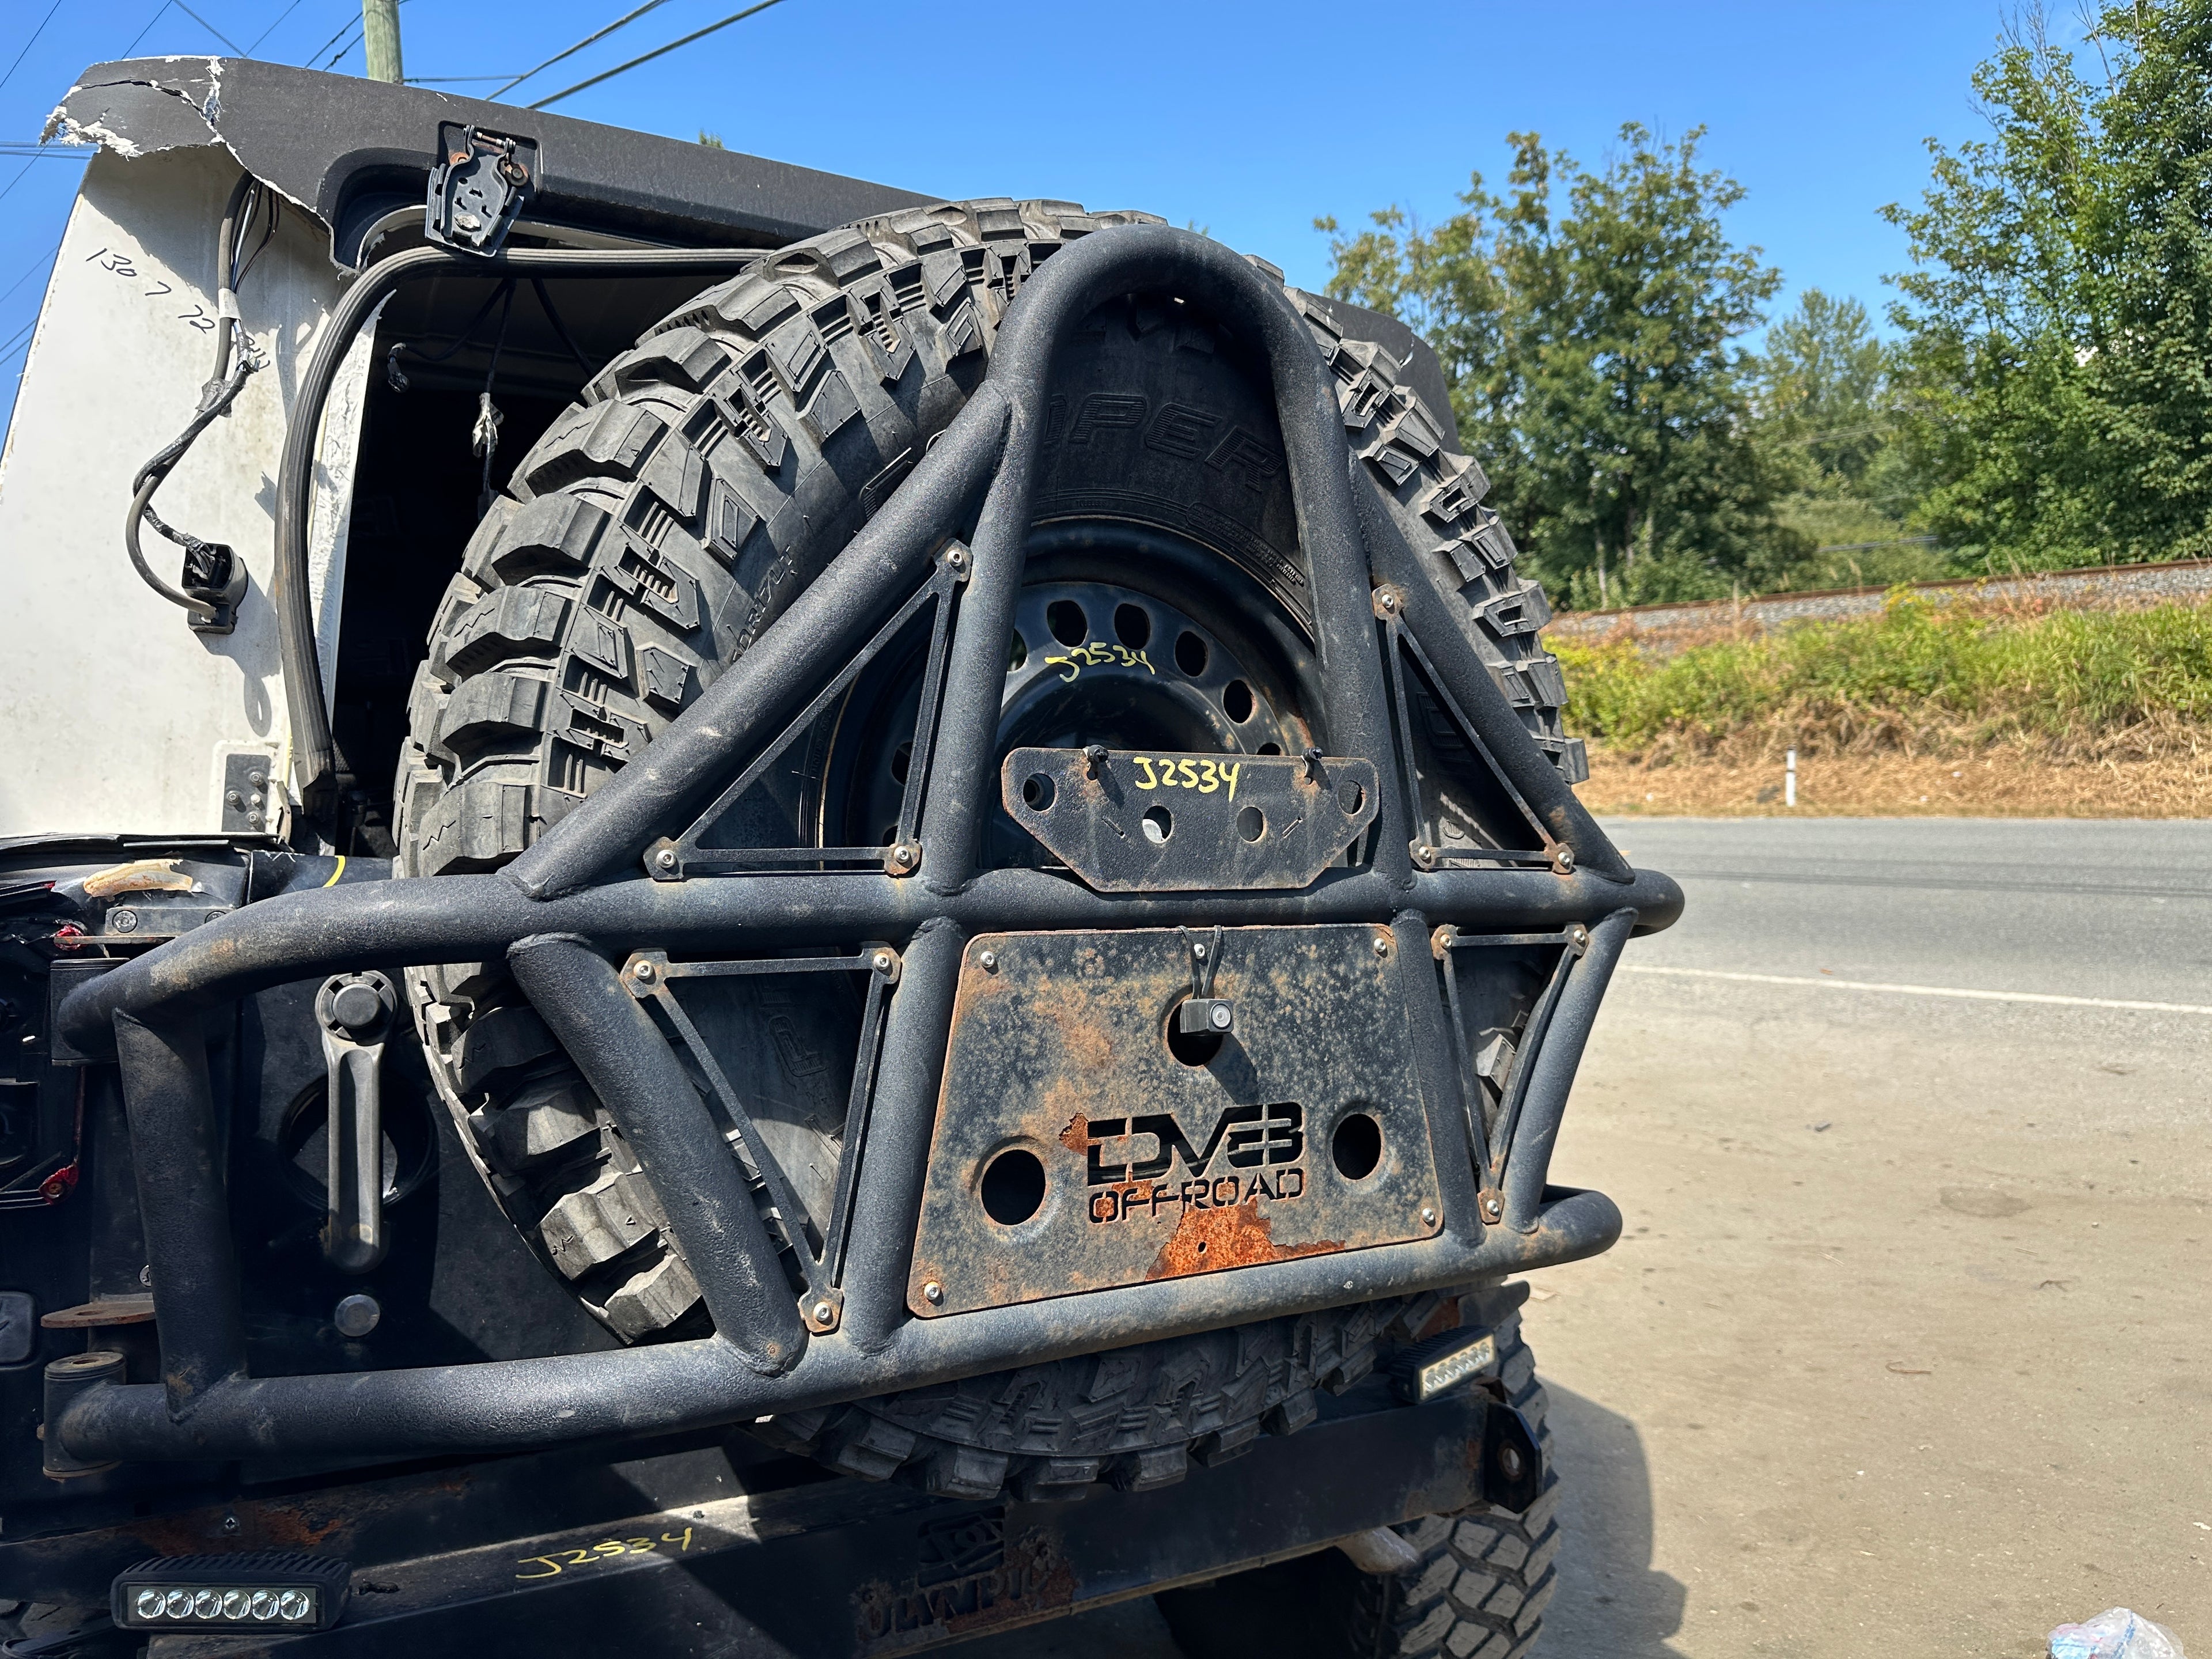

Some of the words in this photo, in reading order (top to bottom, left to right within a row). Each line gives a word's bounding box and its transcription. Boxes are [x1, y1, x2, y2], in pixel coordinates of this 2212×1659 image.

[1044, 642, 1156, 683] J2534
[1132, 756, 1241, 802] J2534
[515, 1527, 692, 1580] J2534
